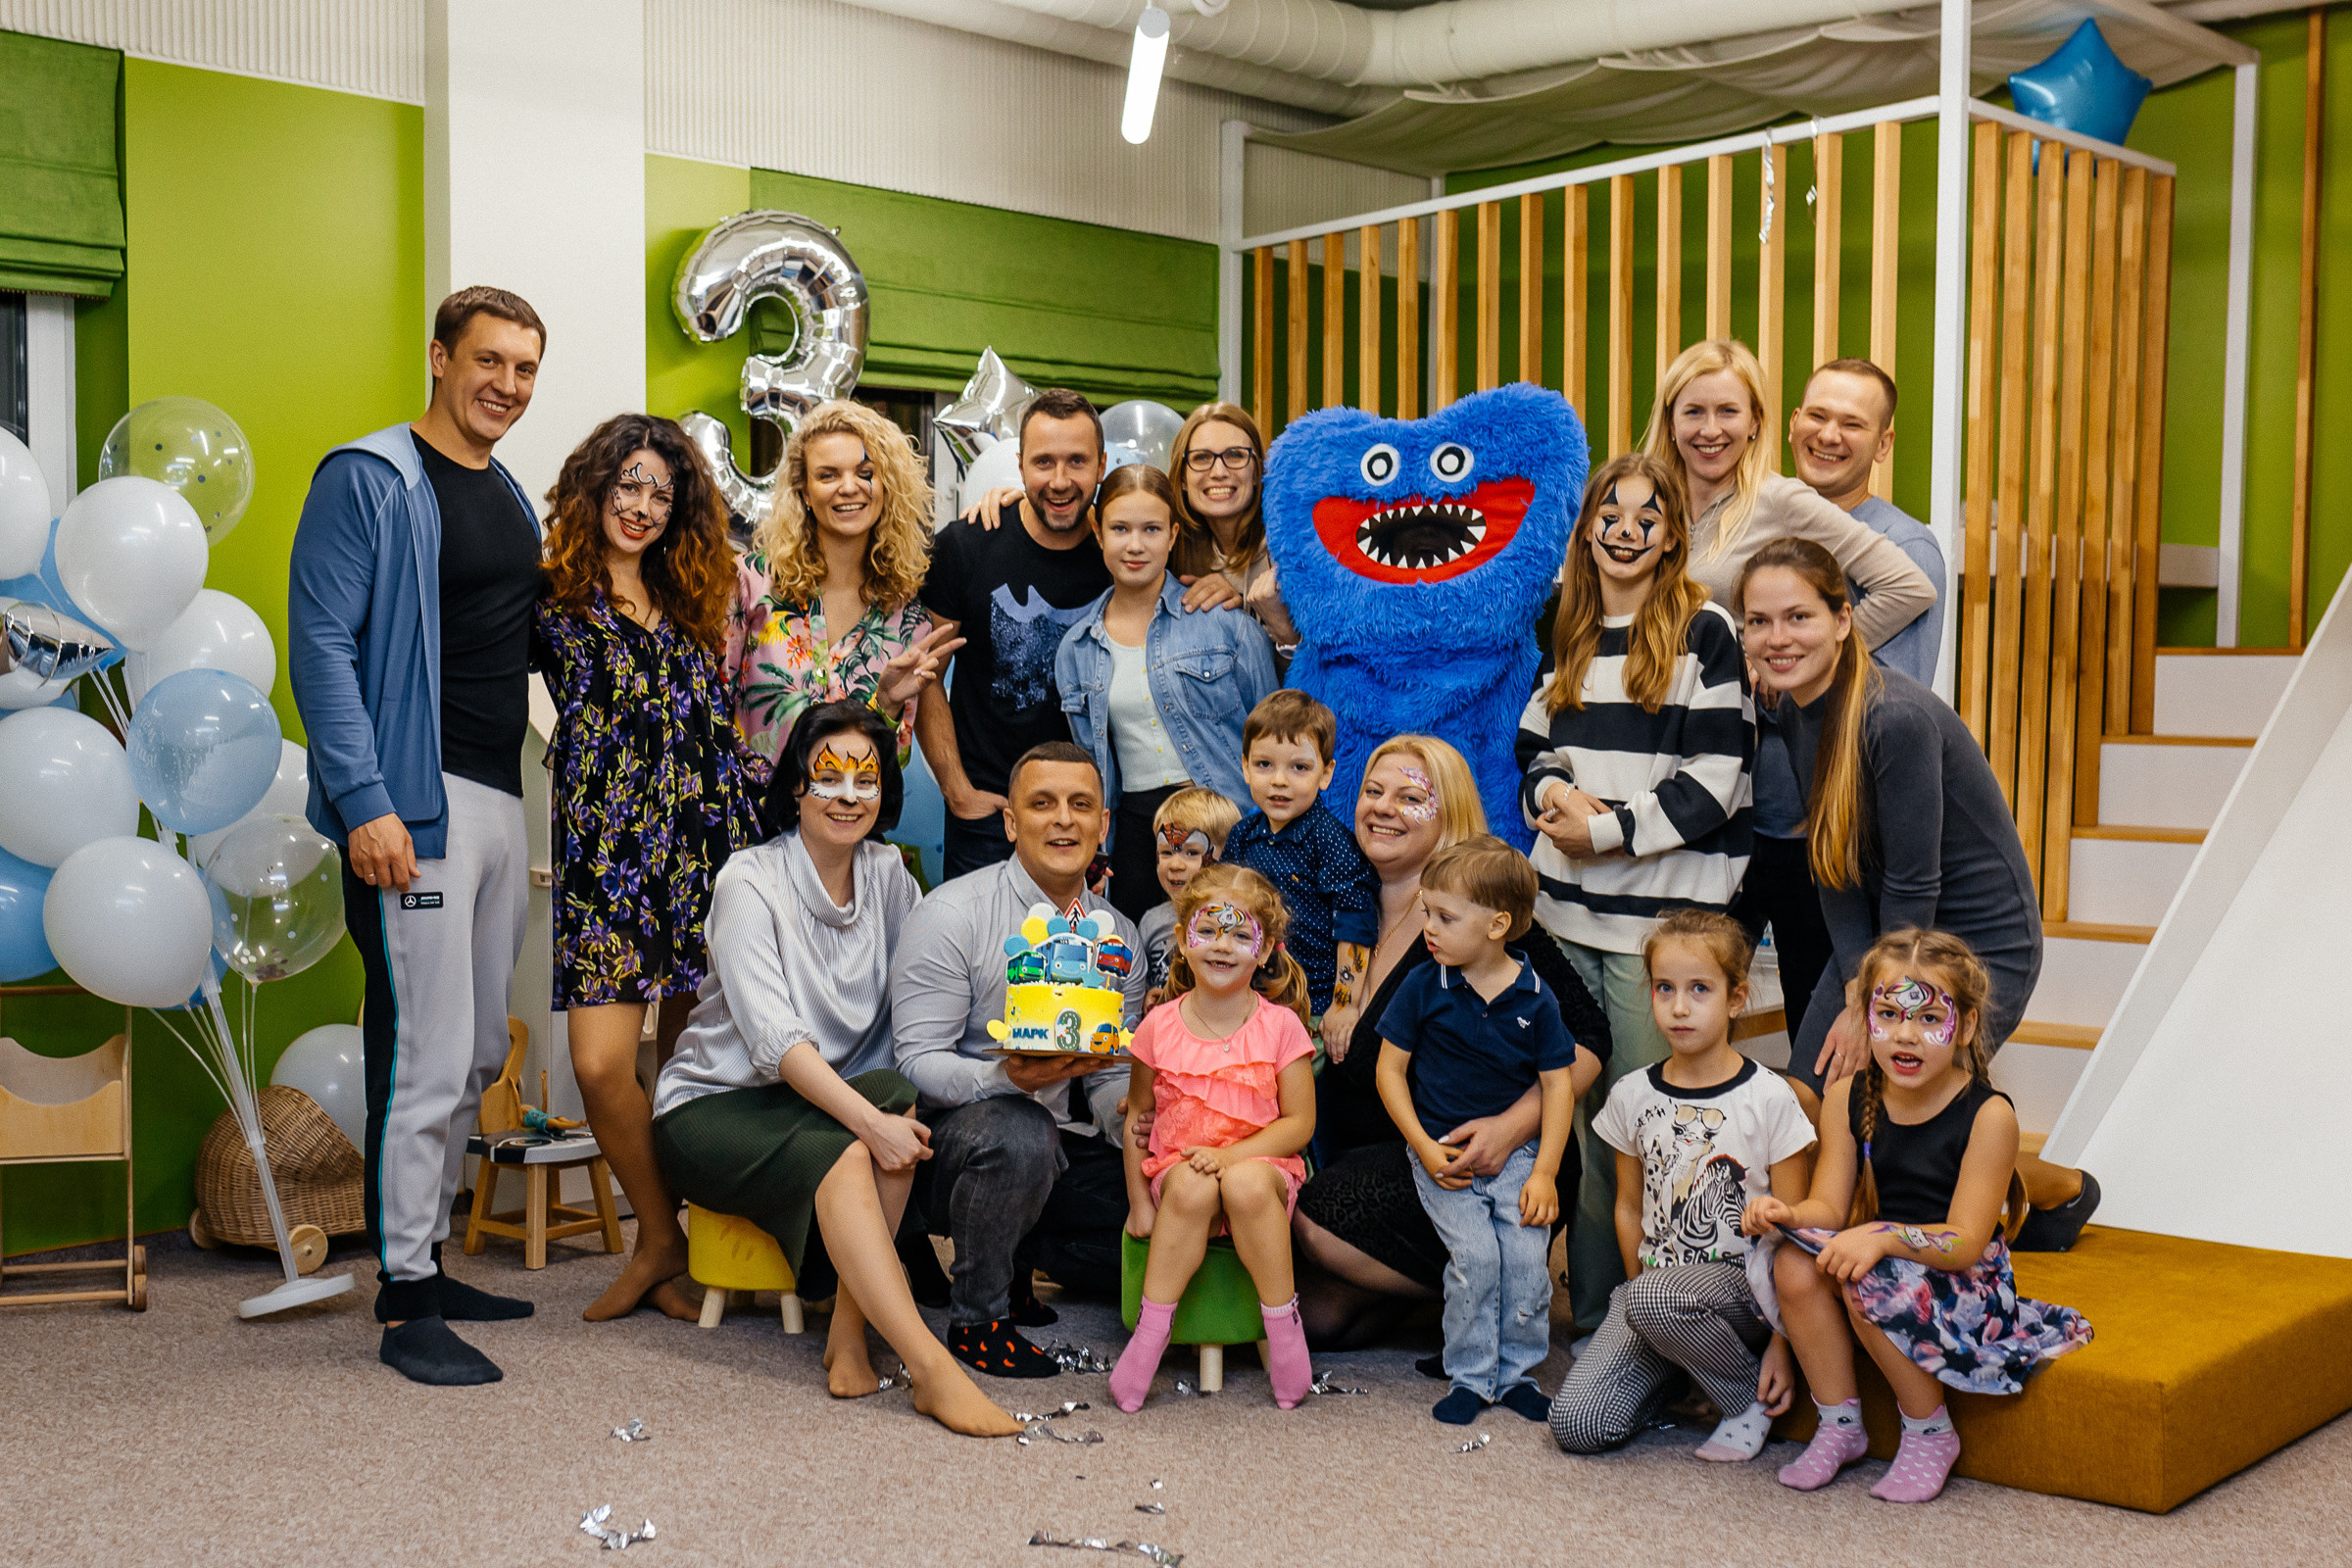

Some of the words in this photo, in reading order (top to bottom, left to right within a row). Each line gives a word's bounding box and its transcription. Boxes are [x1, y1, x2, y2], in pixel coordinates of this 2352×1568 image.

[672, 208, 871, 547] 3
[1012, 1028, 1049, 1040] МАРК
[1056, 1009, 1081, 1051] 3
